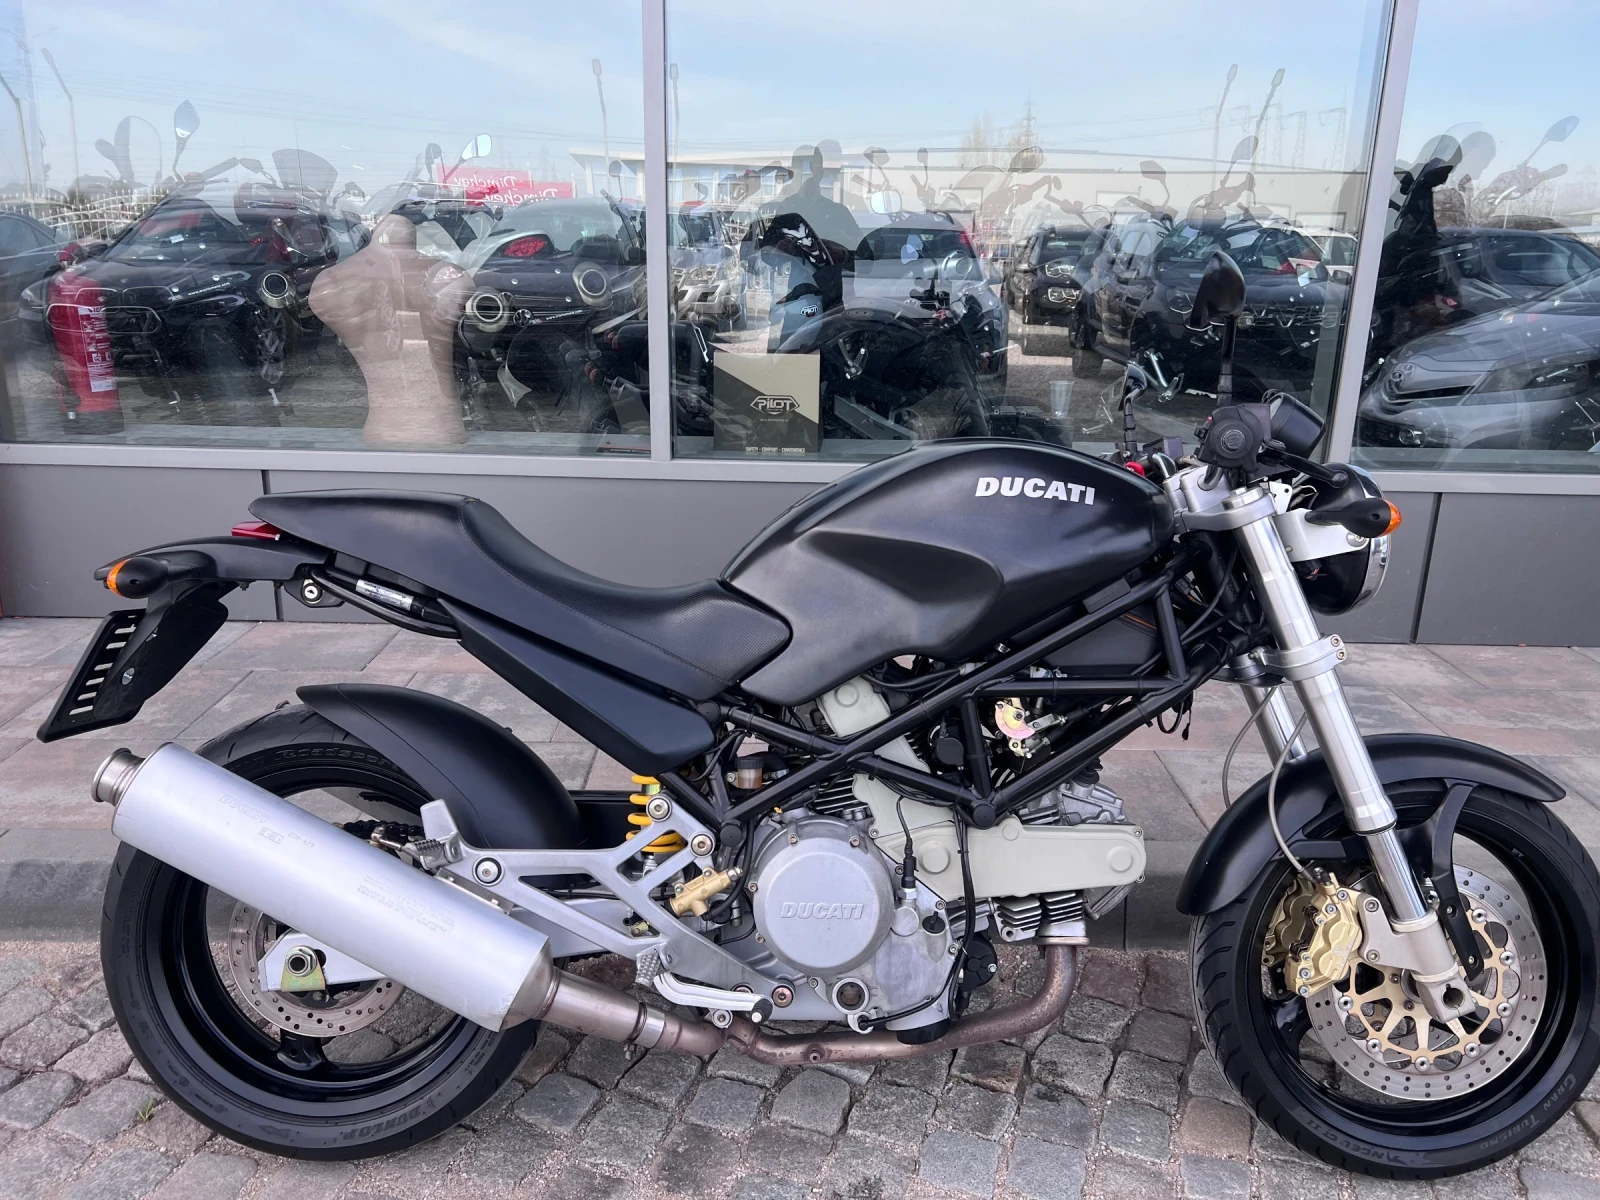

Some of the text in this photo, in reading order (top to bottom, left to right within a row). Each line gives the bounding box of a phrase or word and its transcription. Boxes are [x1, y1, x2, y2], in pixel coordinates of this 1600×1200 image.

[975, 476, 1096, 506] DUCATI
[219, 793, 269, 824] DUCATI
[780, 901, 864, 920] DUCATI
[343, 1104, 422, 1141] DUNLOP
